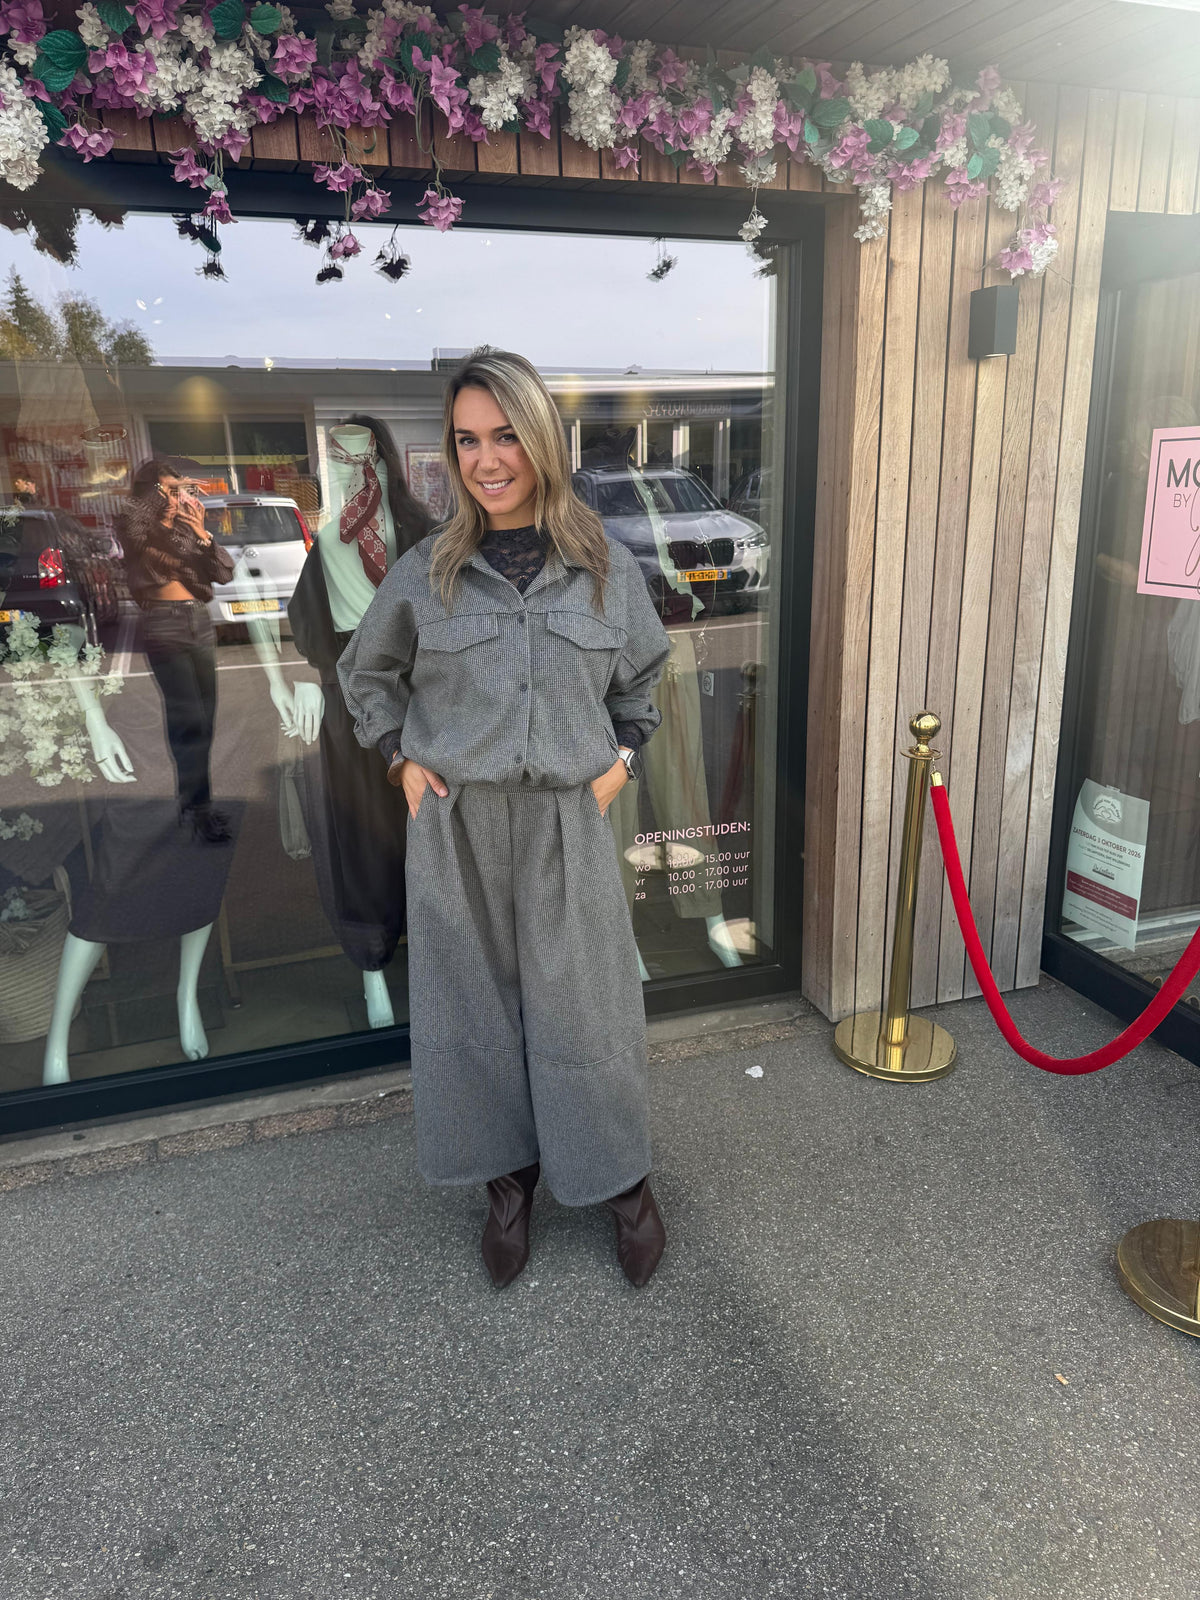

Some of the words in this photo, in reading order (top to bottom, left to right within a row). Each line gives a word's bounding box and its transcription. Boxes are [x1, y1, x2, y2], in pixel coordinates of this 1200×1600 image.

[1173, 493, 1192, 508] BY
[634, 821, 751, 845] OPENINGSTIJDEN:
[1101, 839, 1127, 853] OKTOBER
[635, 864, 651, 873] wo
[705, 852, 731, 864] 15.00
[734, 850, 751, 860] uur
[635, 878, 646, 886] vr
[668, 870, 695, 882] 10.00
[705, 865, 730, 877] 17.00
[732, 864, 749, 873] uur
[635, 891, 646, 900] za
[668, 883, 695, 896] 10.00
[705, 879, 730, 891] 17.00
[732, 877, 749, 887] uur
